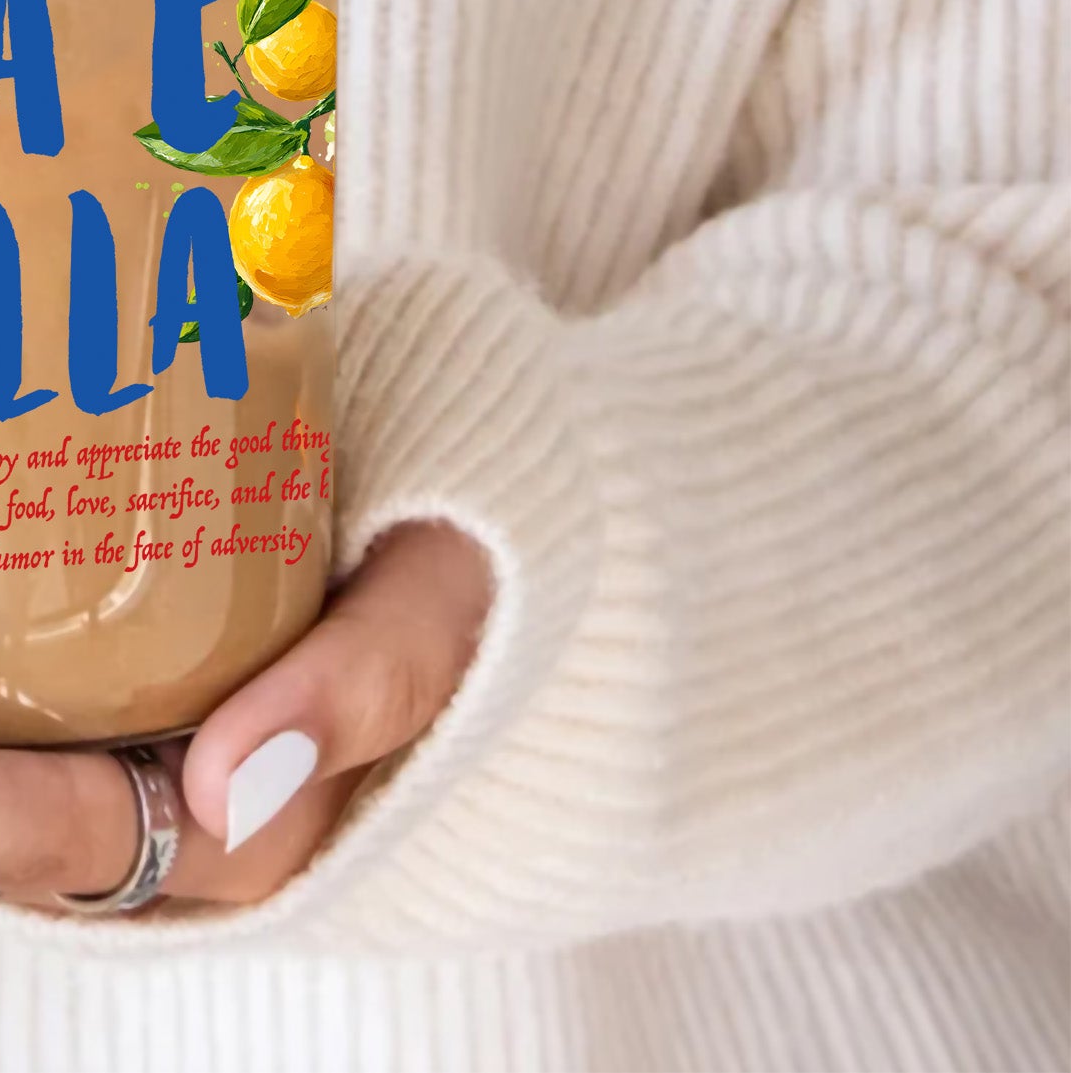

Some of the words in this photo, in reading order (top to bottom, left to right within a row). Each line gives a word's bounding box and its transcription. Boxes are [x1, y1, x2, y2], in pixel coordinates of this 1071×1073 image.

[27, 435, 72, 471] and
[76, 436, 182, 481] appreciate
[190, 424, 221, 458] the
[224, 420, 277, 470] good
[66, 484, 117, 518] love,
[125, 477, 221, 520] sacrifice,
[230, 470, 277, 505] and
[280, 468, 311, 502] the
[62, 540, 86, 567] in
[94, 531, 126, 565] the
[124, 529, 174, 573] face
[181, 525, 207, 569] of
[210, 522, 313, 566] adversity
